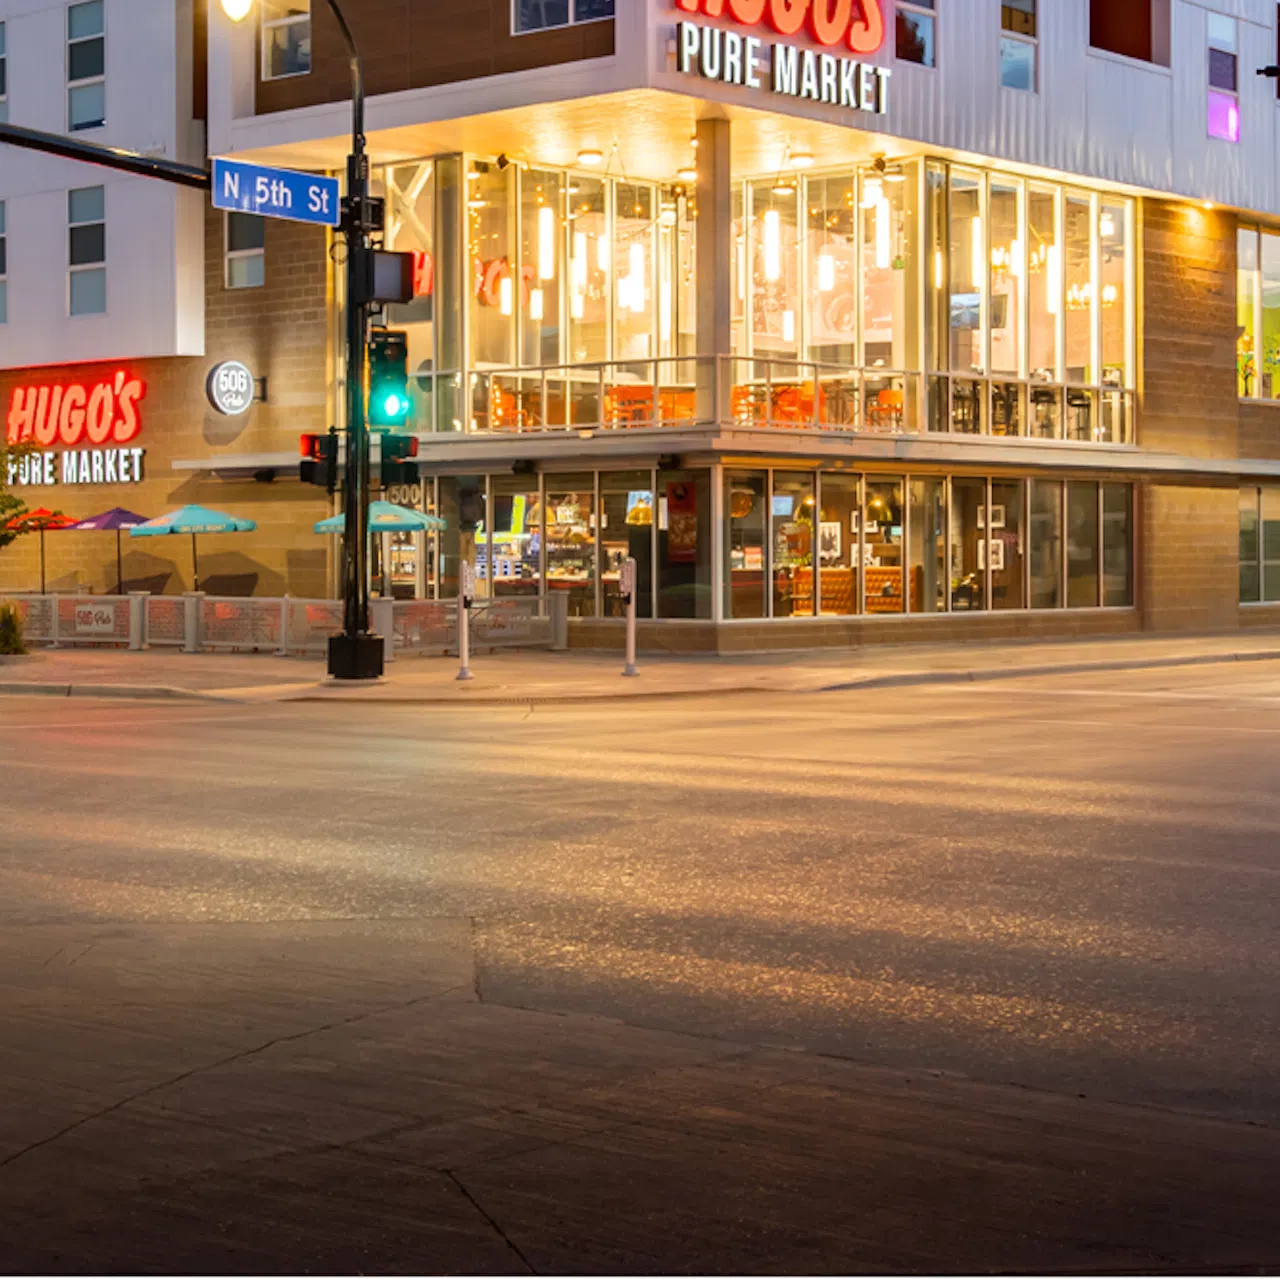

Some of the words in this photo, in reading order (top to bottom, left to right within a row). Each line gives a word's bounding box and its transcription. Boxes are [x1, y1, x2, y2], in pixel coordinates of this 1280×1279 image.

[678, 20, 761, 89] PURE
[771, 42, 892, 115] MARKET
[223, 170, 240, 200] N
[255, 175, 293, 209] 5th
[307, 185, 330, 215] St
[219, 370, 248, 392] 506
[7, 370, 146, 446] HUGO'S
[62, 447, 144, 484] MARKET
[390, 484, 422, 505] 500
